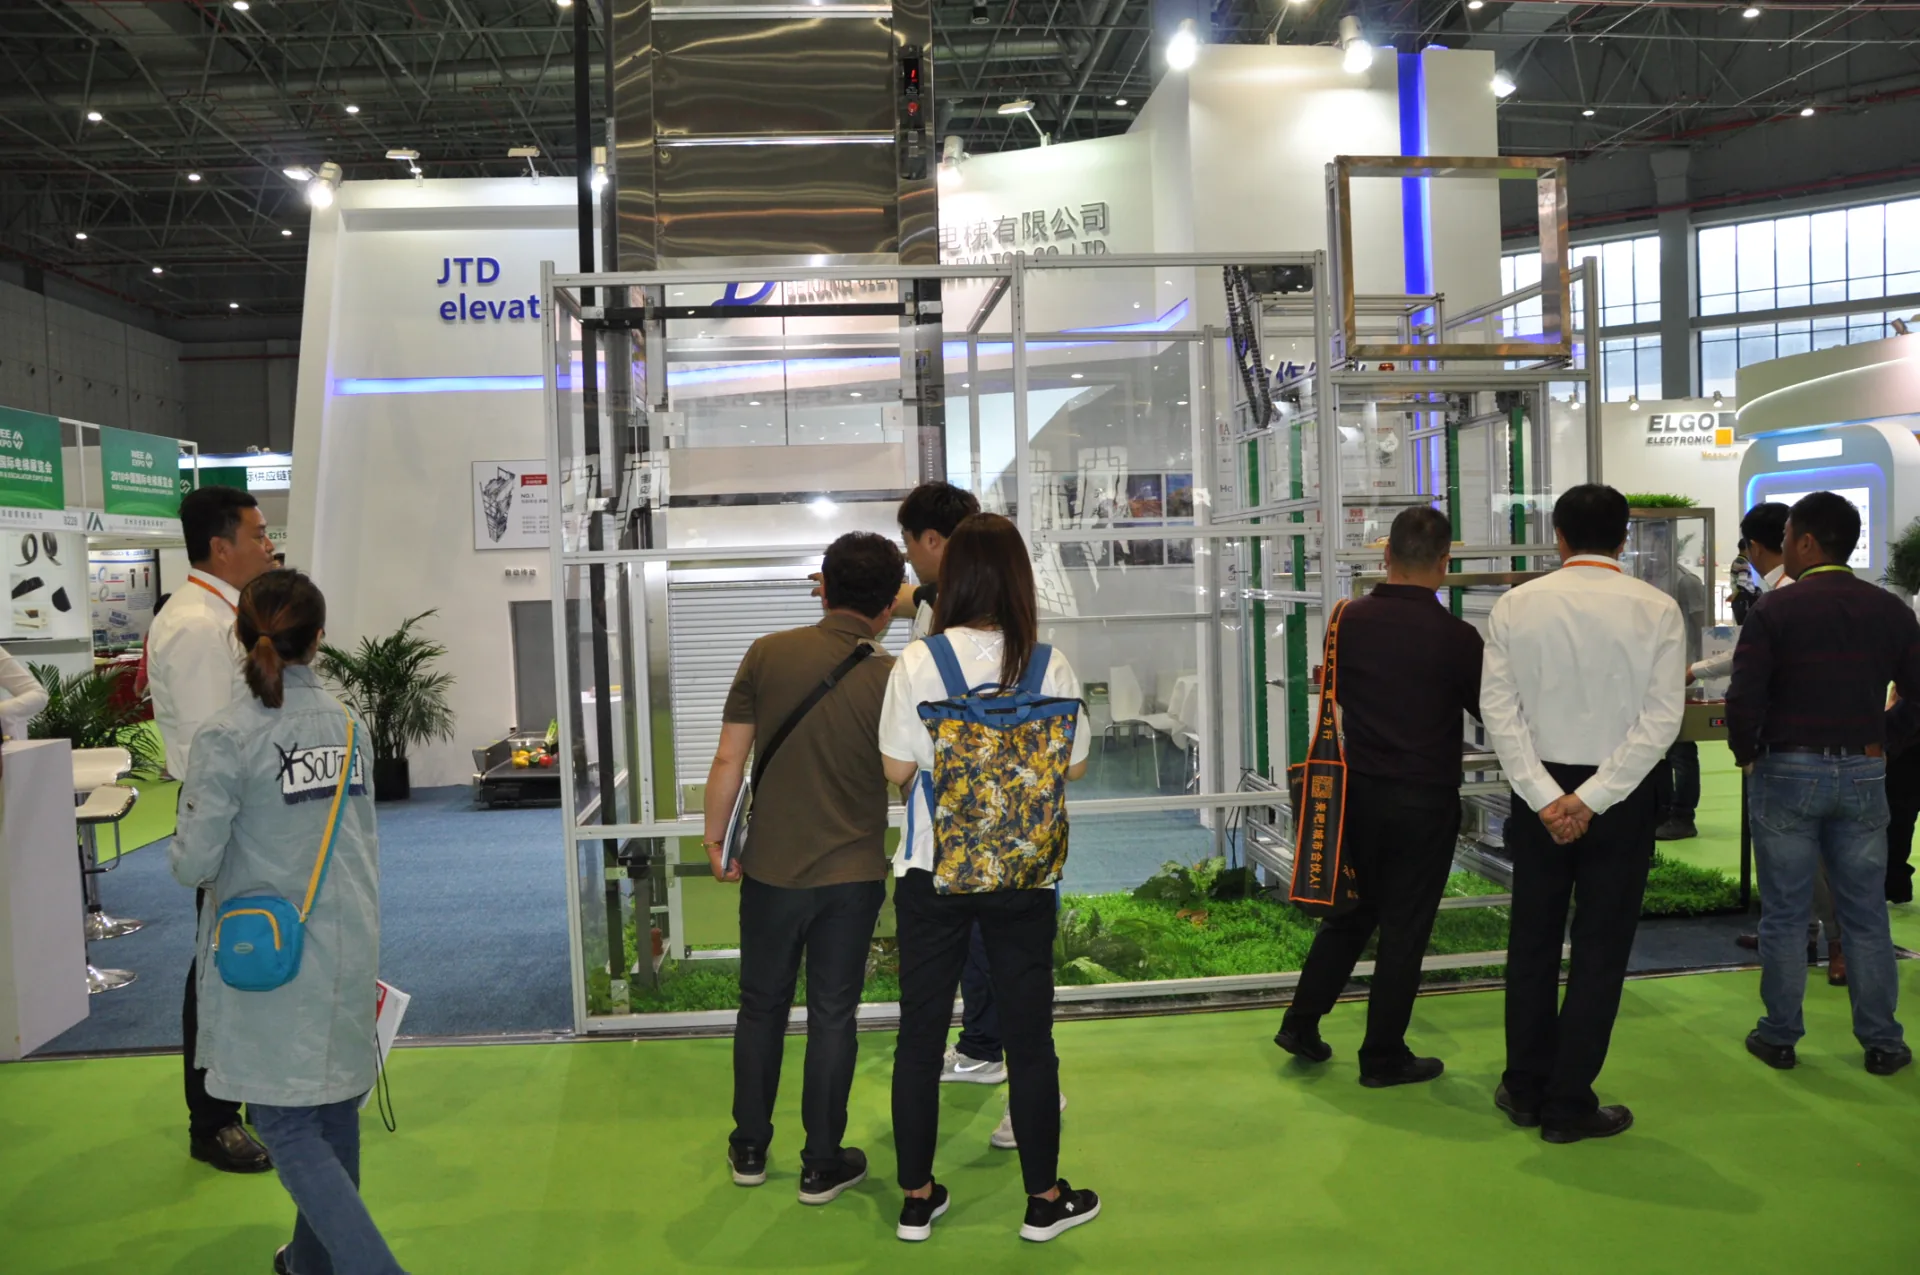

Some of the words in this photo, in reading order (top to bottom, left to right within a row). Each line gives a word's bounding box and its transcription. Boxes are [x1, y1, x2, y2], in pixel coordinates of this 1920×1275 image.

[939, 202, 1107, 251] 电梯有限公司
[437, 257, 500, 285] JTD
[440, 293, 540, 321] elevat
[1647, 413, 1715, 433] ELGO
[1646, 435, 1713, 445] ELECTRONIC
